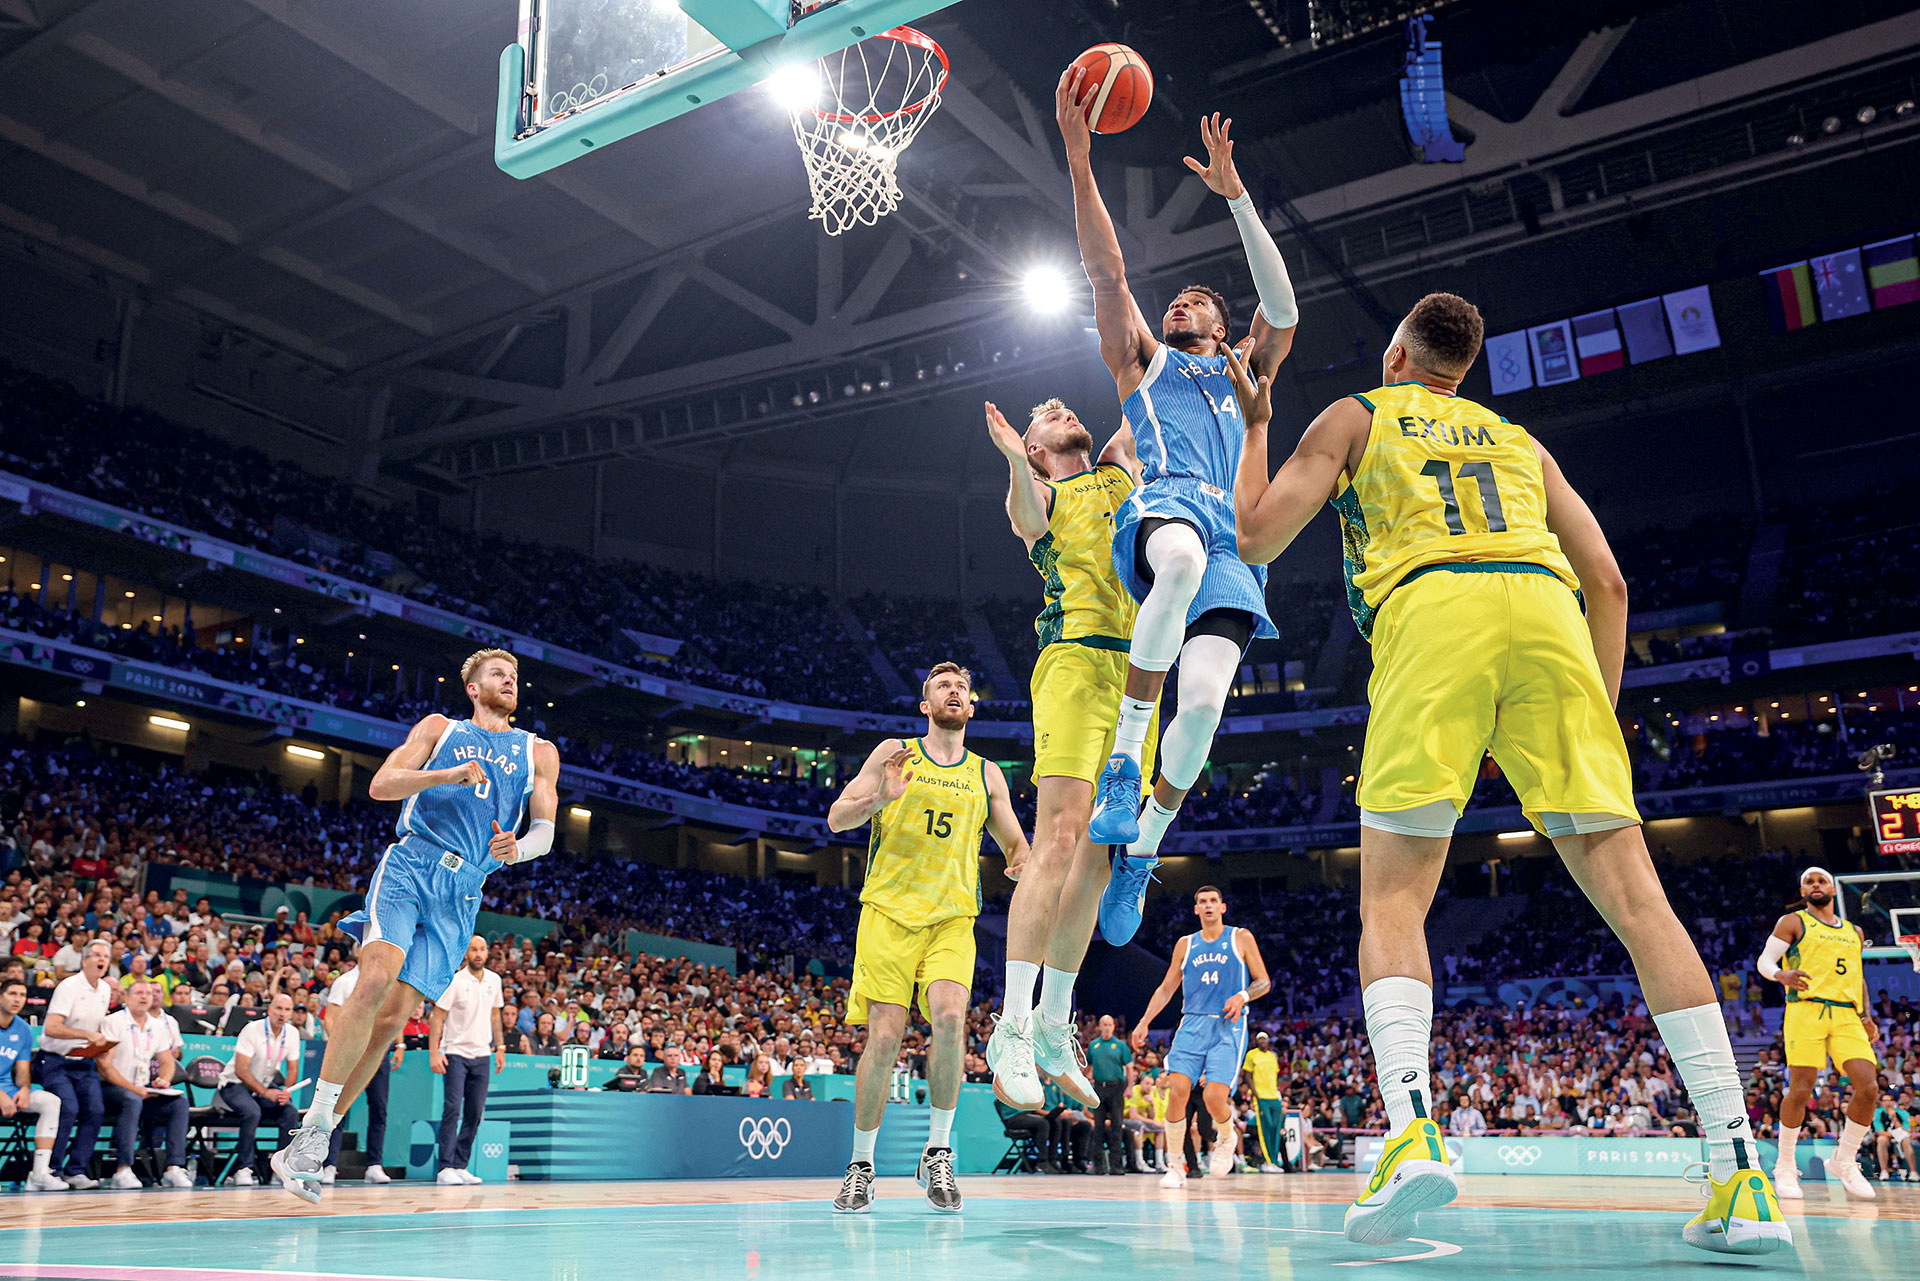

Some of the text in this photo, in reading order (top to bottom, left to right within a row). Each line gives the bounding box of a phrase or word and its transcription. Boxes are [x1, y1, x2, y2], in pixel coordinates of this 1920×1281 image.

[1398, 416, 1497, 446] EXUM
[1419, 459, 1508, 536] 11
[125, 671, 204, 699] PARIS 2024
[453, 745, 518, 775] HELLAS
[916, 775, 971, 792] AUSTRALIA
[924, 808, 954, 839] 15
[1191, 952, 1229, 968] HELLAS
[1835, 957, 1848, 976] 5
[1201, 970, 1219, 985] 44
[0, 1045, 18, 1061] LAS
[1587, 1150, 1692, 1163] PARIS 2024
